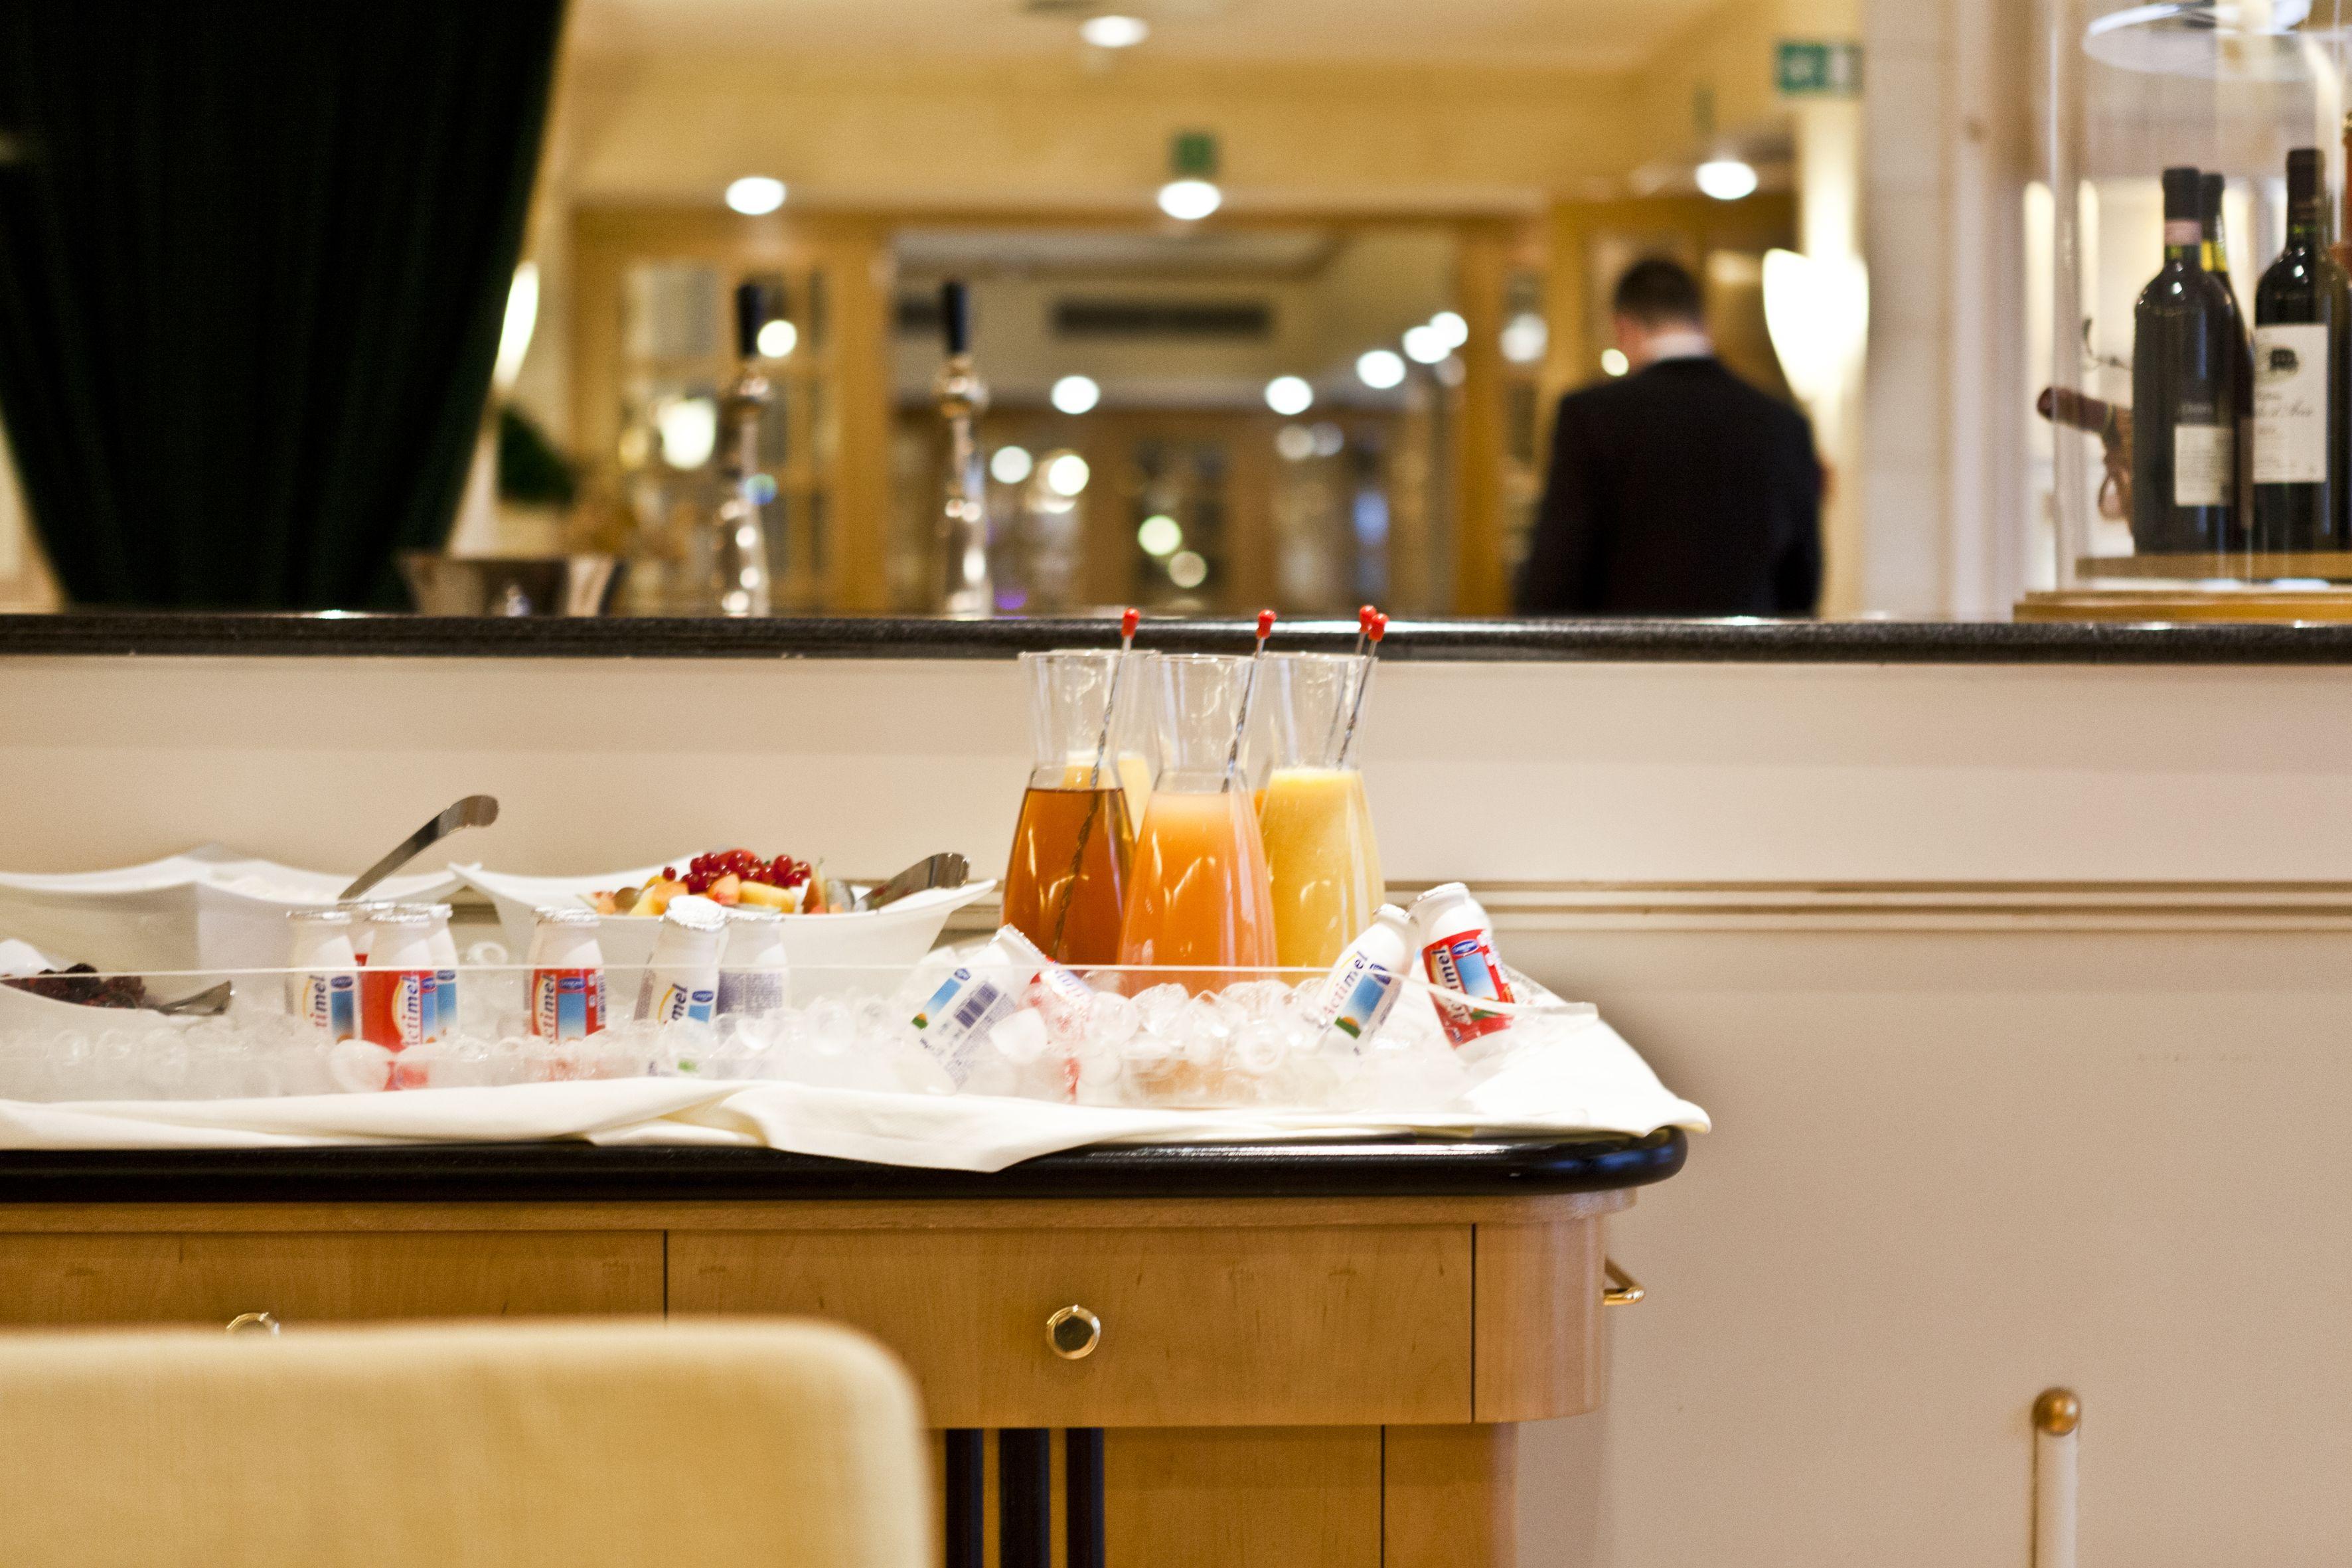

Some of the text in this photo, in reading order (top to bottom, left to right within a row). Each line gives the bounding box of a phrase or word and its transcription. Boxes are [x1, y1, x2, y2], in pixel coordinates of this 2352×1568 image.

[309, 975, 327, 1027] timel
[540, 975, 555, 1044] ctimel
[1431, 949, 1465, 1019] Acimel
